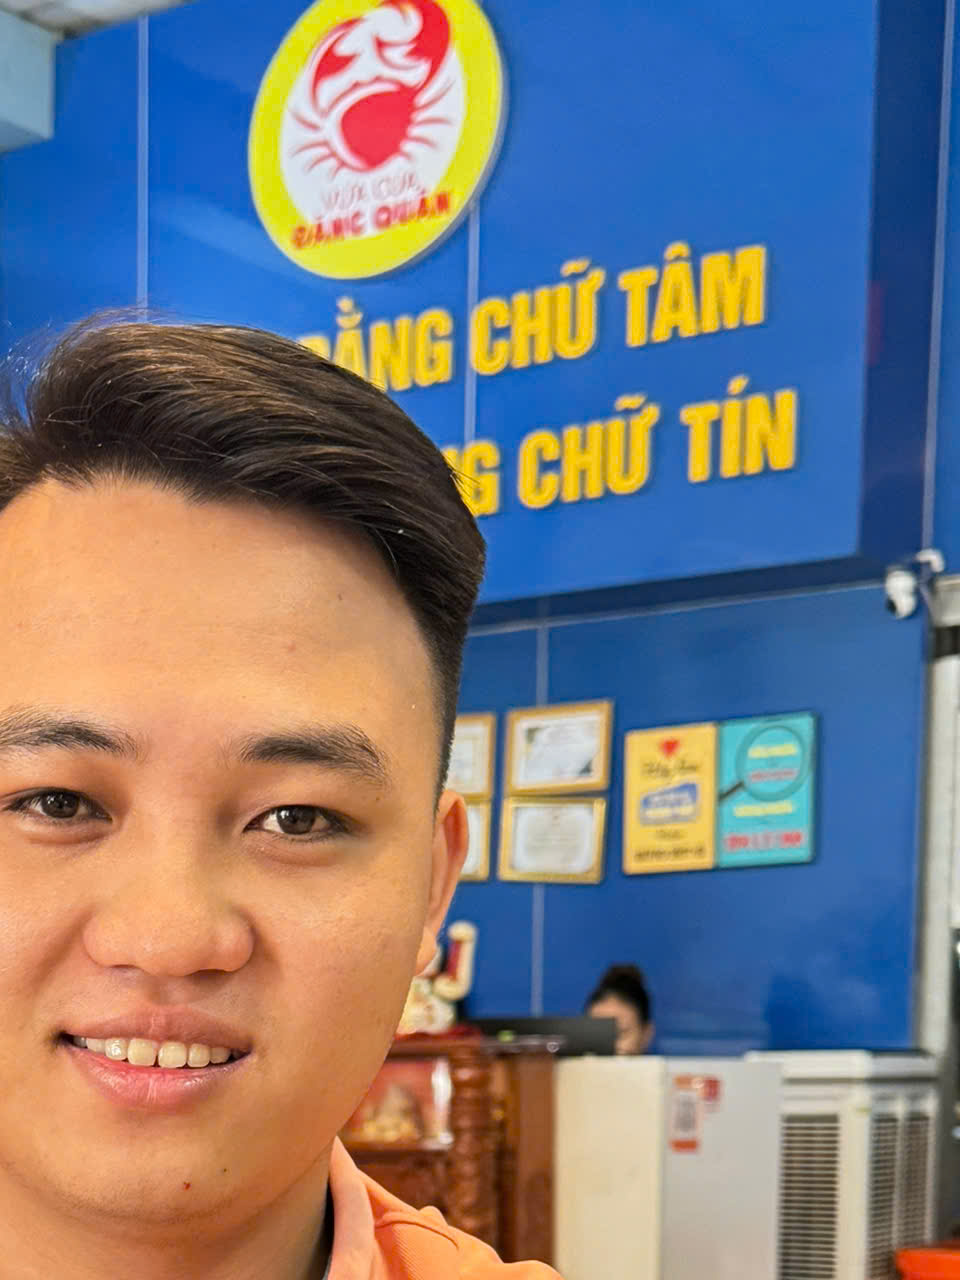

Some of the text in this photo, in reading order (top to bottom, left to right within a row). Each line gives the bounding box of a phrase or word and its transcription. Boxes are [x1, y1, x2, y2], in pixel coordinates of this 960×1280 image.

[470, 258, 606, 375] CHỮ
[618, 241, 767, 347] TÂM
[518, 394, 660, 509] CHỮ
[680, 375, 798, 483] TÍN
